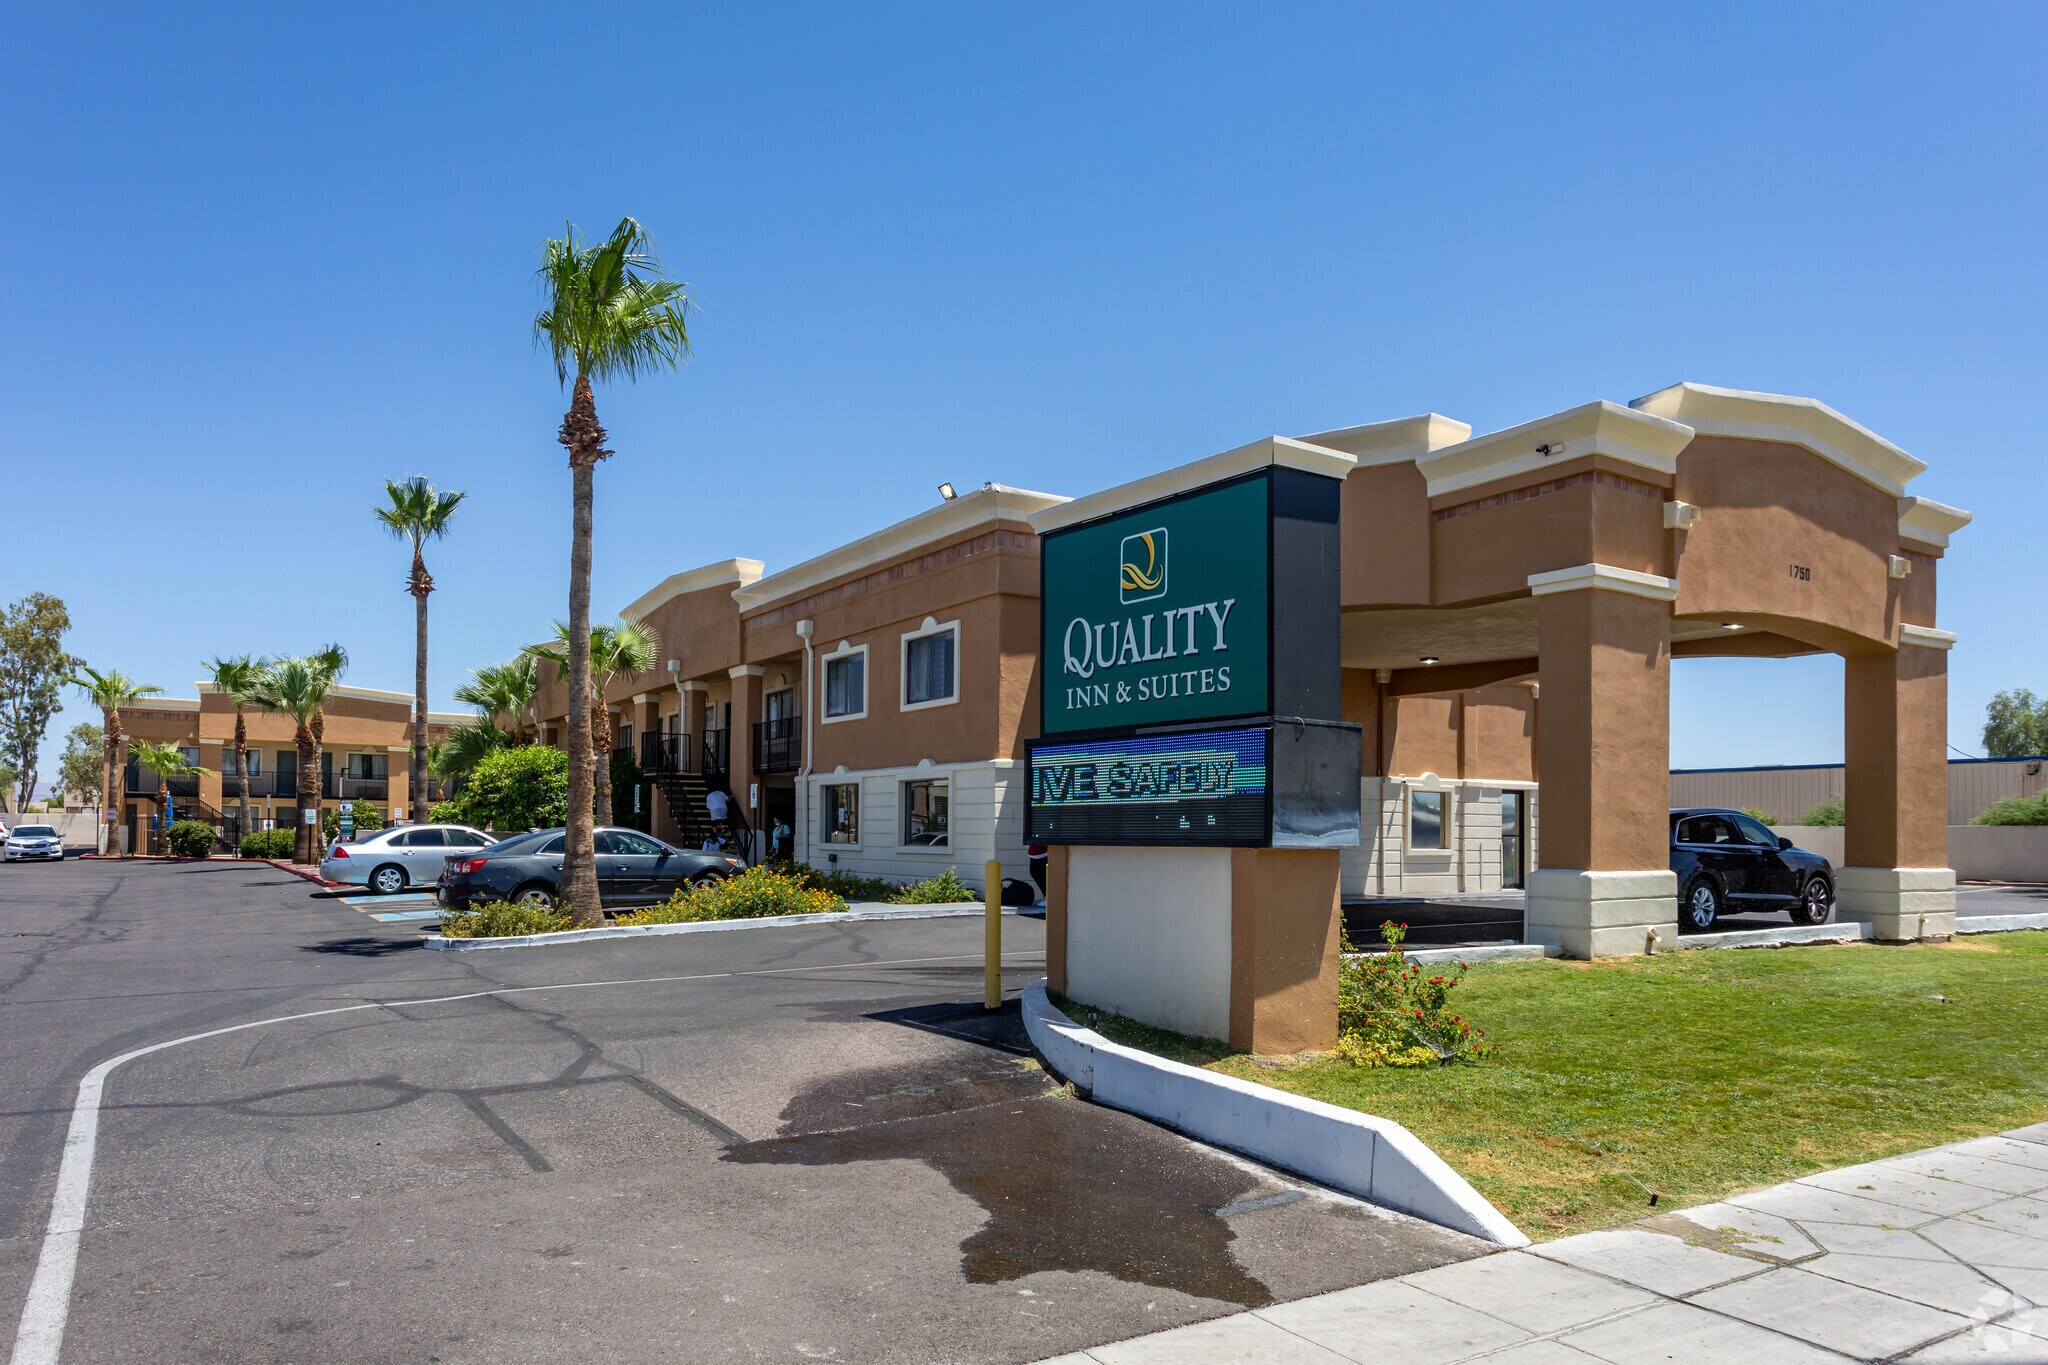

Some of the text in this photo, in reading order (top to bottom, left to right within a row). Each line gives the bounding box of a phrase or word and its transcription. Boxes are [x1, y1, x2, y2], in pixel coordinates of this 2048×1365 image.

[1790, 564, 1810, 581] 1750
[1064, 599, 1235, 679] QUALITY
[1067, 666, 1231, 709] INN & SUITES
[1110, 761, 1234, 794] SAFELY
